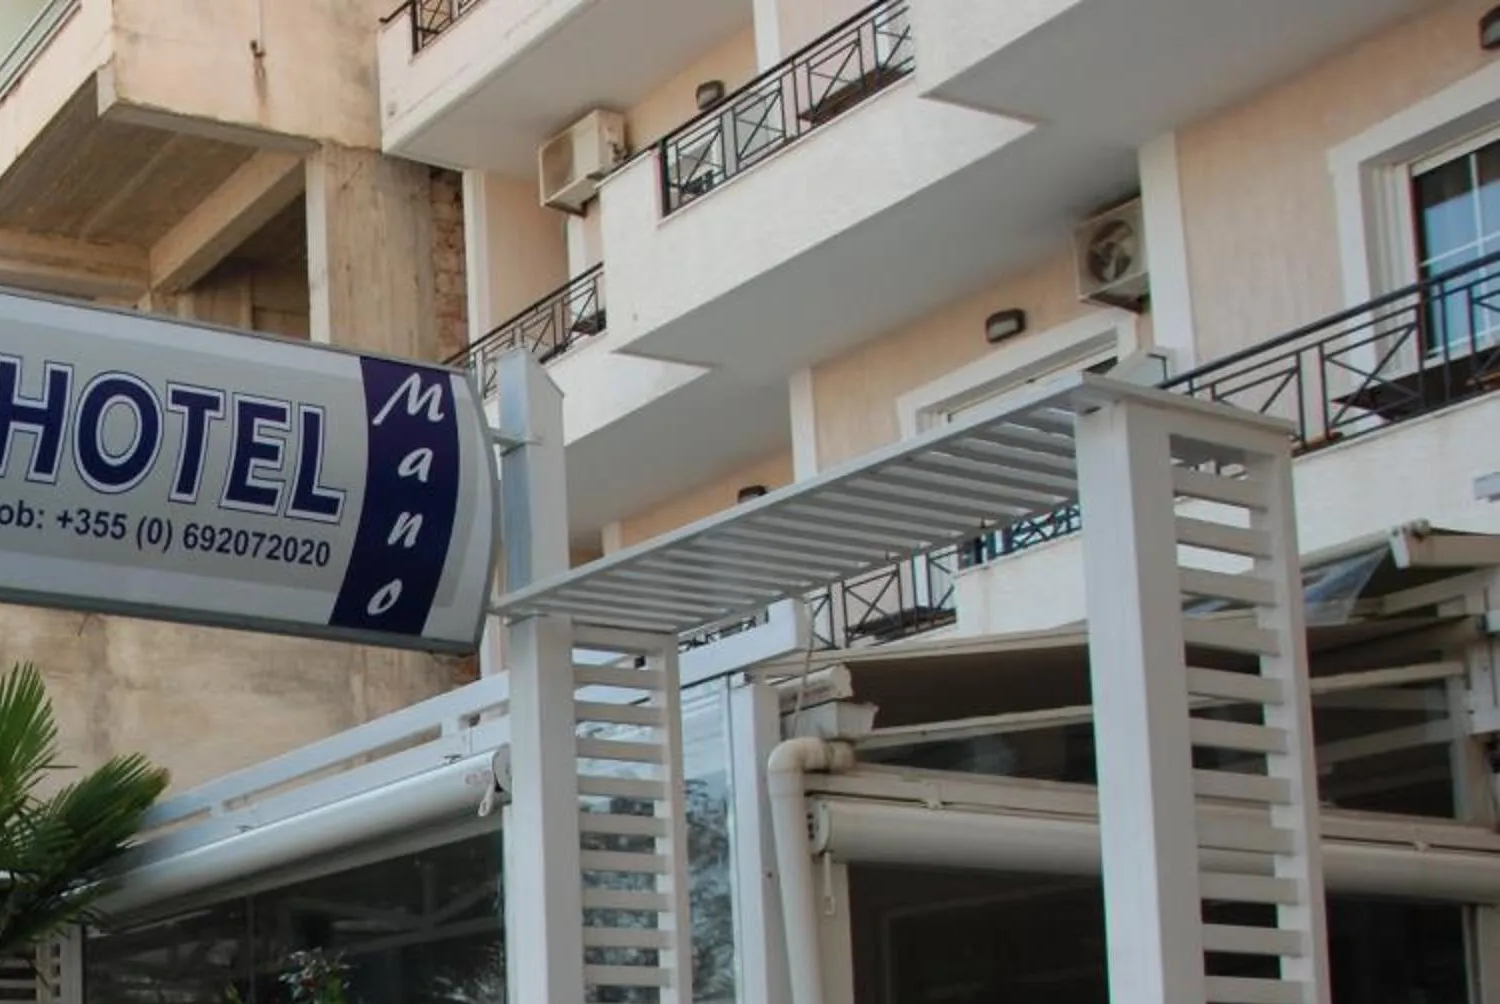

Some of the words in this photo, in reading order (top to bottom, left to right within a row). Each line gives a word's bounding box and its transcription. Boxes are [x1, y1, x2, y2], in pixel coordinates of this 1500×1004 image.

[56, 507, 128, 541] +355
[136, 516, 174, 553] (0)
[182, 521, 332, 568] 692072020
[367, 371, 445, 616] Mano
